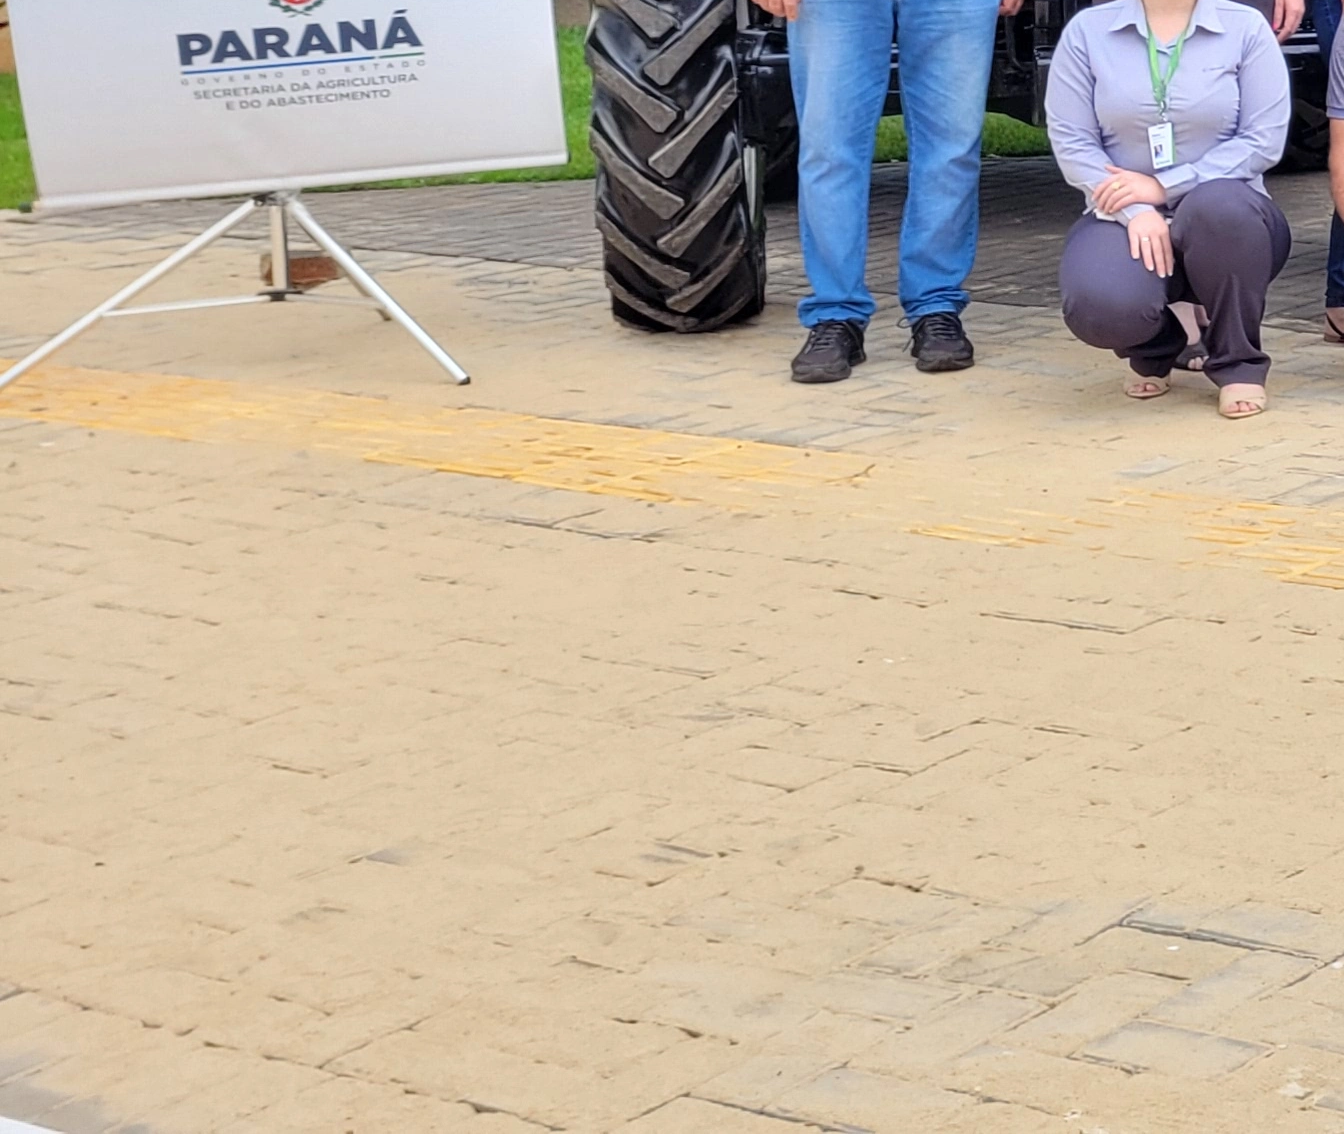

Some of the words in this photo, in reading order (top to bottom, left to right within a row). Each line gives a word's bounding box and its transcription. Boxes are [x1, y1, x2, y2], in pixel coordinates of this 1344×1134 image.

[177, 9, 423, 66] PARANÁ
[181, 71, 284, 86] GOVERNO
[301, 67, 326, 76] DO
[344, 59, 426, 73] ESTADO
[193, 84, 287, 100] SECRETARIA
[290, 82, 311, 92] DA
[316, 73, 419, 90] AGRICULTURA
[225, 100, 236, 111] E
[239, 99, 262, 109] DO
[266, 89, 391, 107] ABASTECIMENTO
